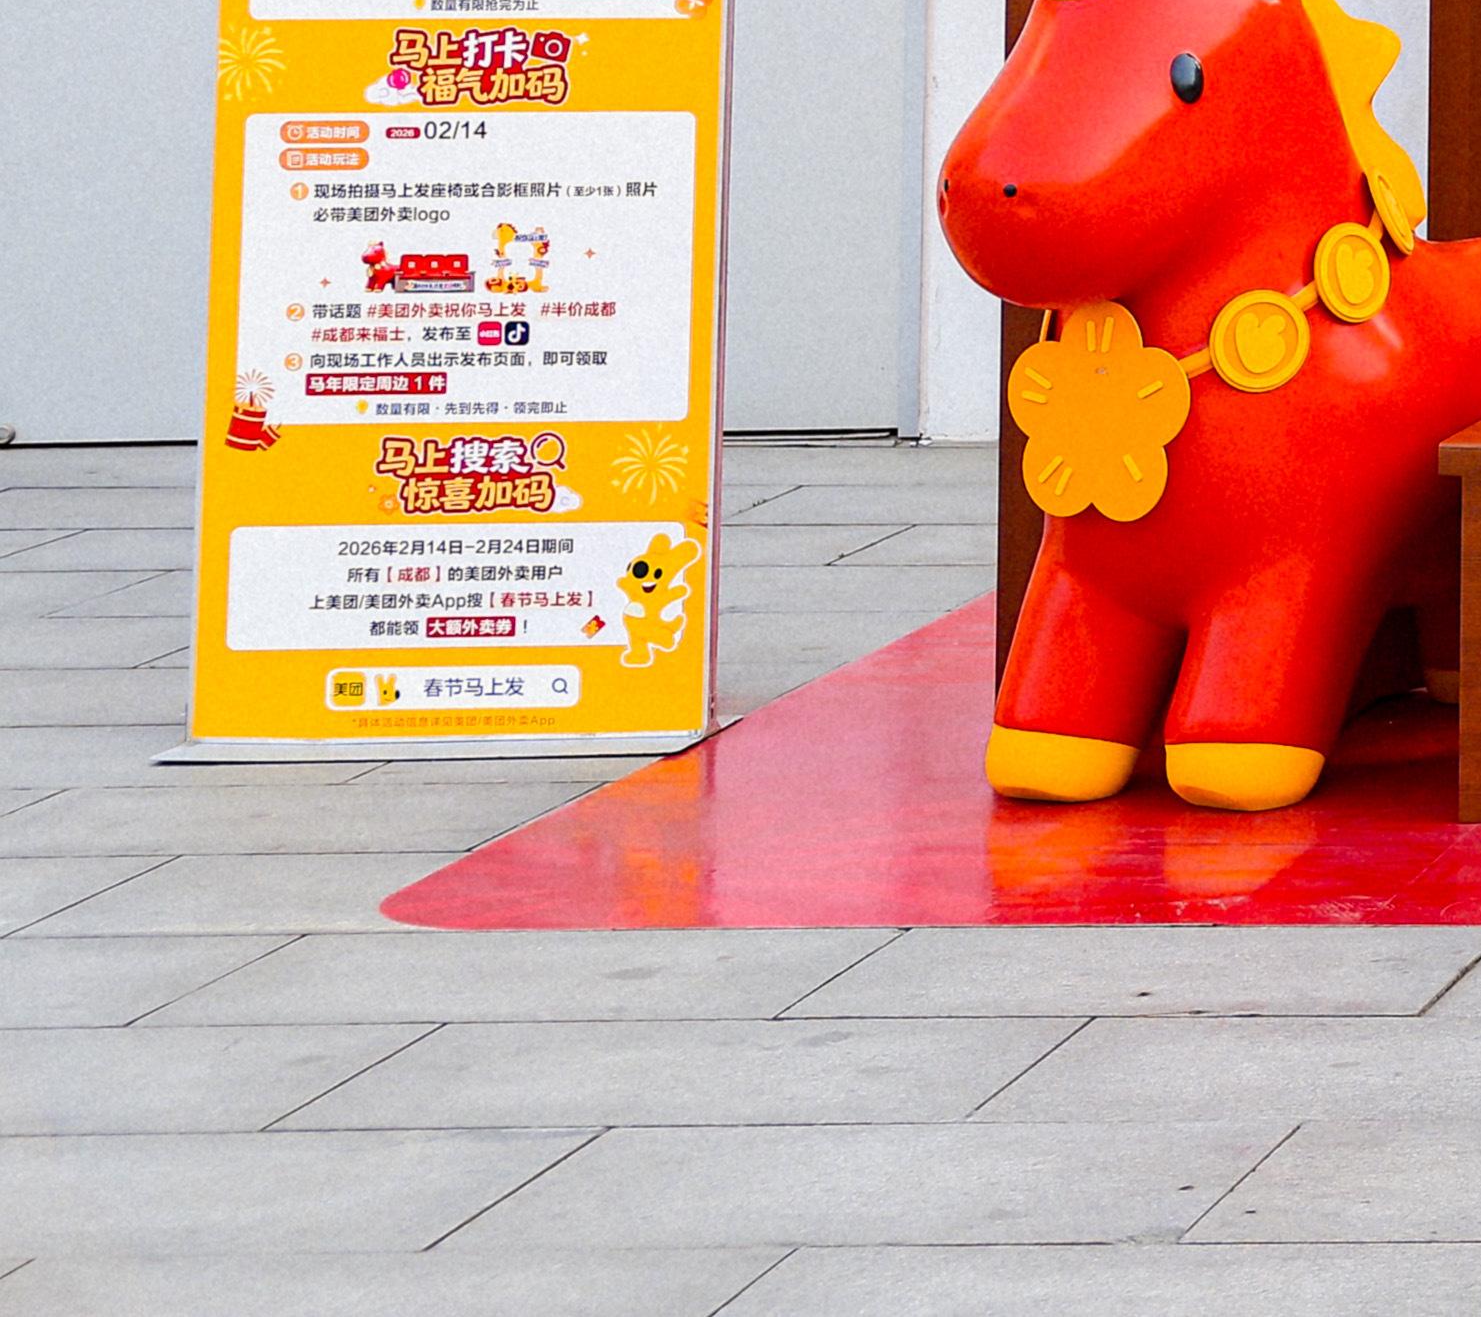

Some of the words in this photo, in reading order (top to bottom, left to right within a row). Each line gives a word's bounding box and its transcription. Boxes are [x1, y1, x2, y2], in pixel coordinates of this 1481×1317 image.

[391, 30, 529, 69] 马上打卡
[420, 67, 566, 104] 福气加码
[306, 125, 361, 140] 活动时间
[424, 121, 488, 141] 02/14
[305, 152, 360, 167] 活动玩法
[312, 206, 451, 225] 必带美团外卖logo
[312, 303, 362, 320] 带话题
[367, 300, 527, 320] #美团外卖祝你马上发
[540, 300, 617, 319] #半价成都
[378, 437, 532, 476] 马上搜索
[401, 474, 555, 513] 惊喜加码
[368, 619, 419, 637] 都能领
[428, 618, 514, 637] 大额外卖券
[333, 680, 364, 698] 美团
[422, 676, 526, 699] 春节马上发
